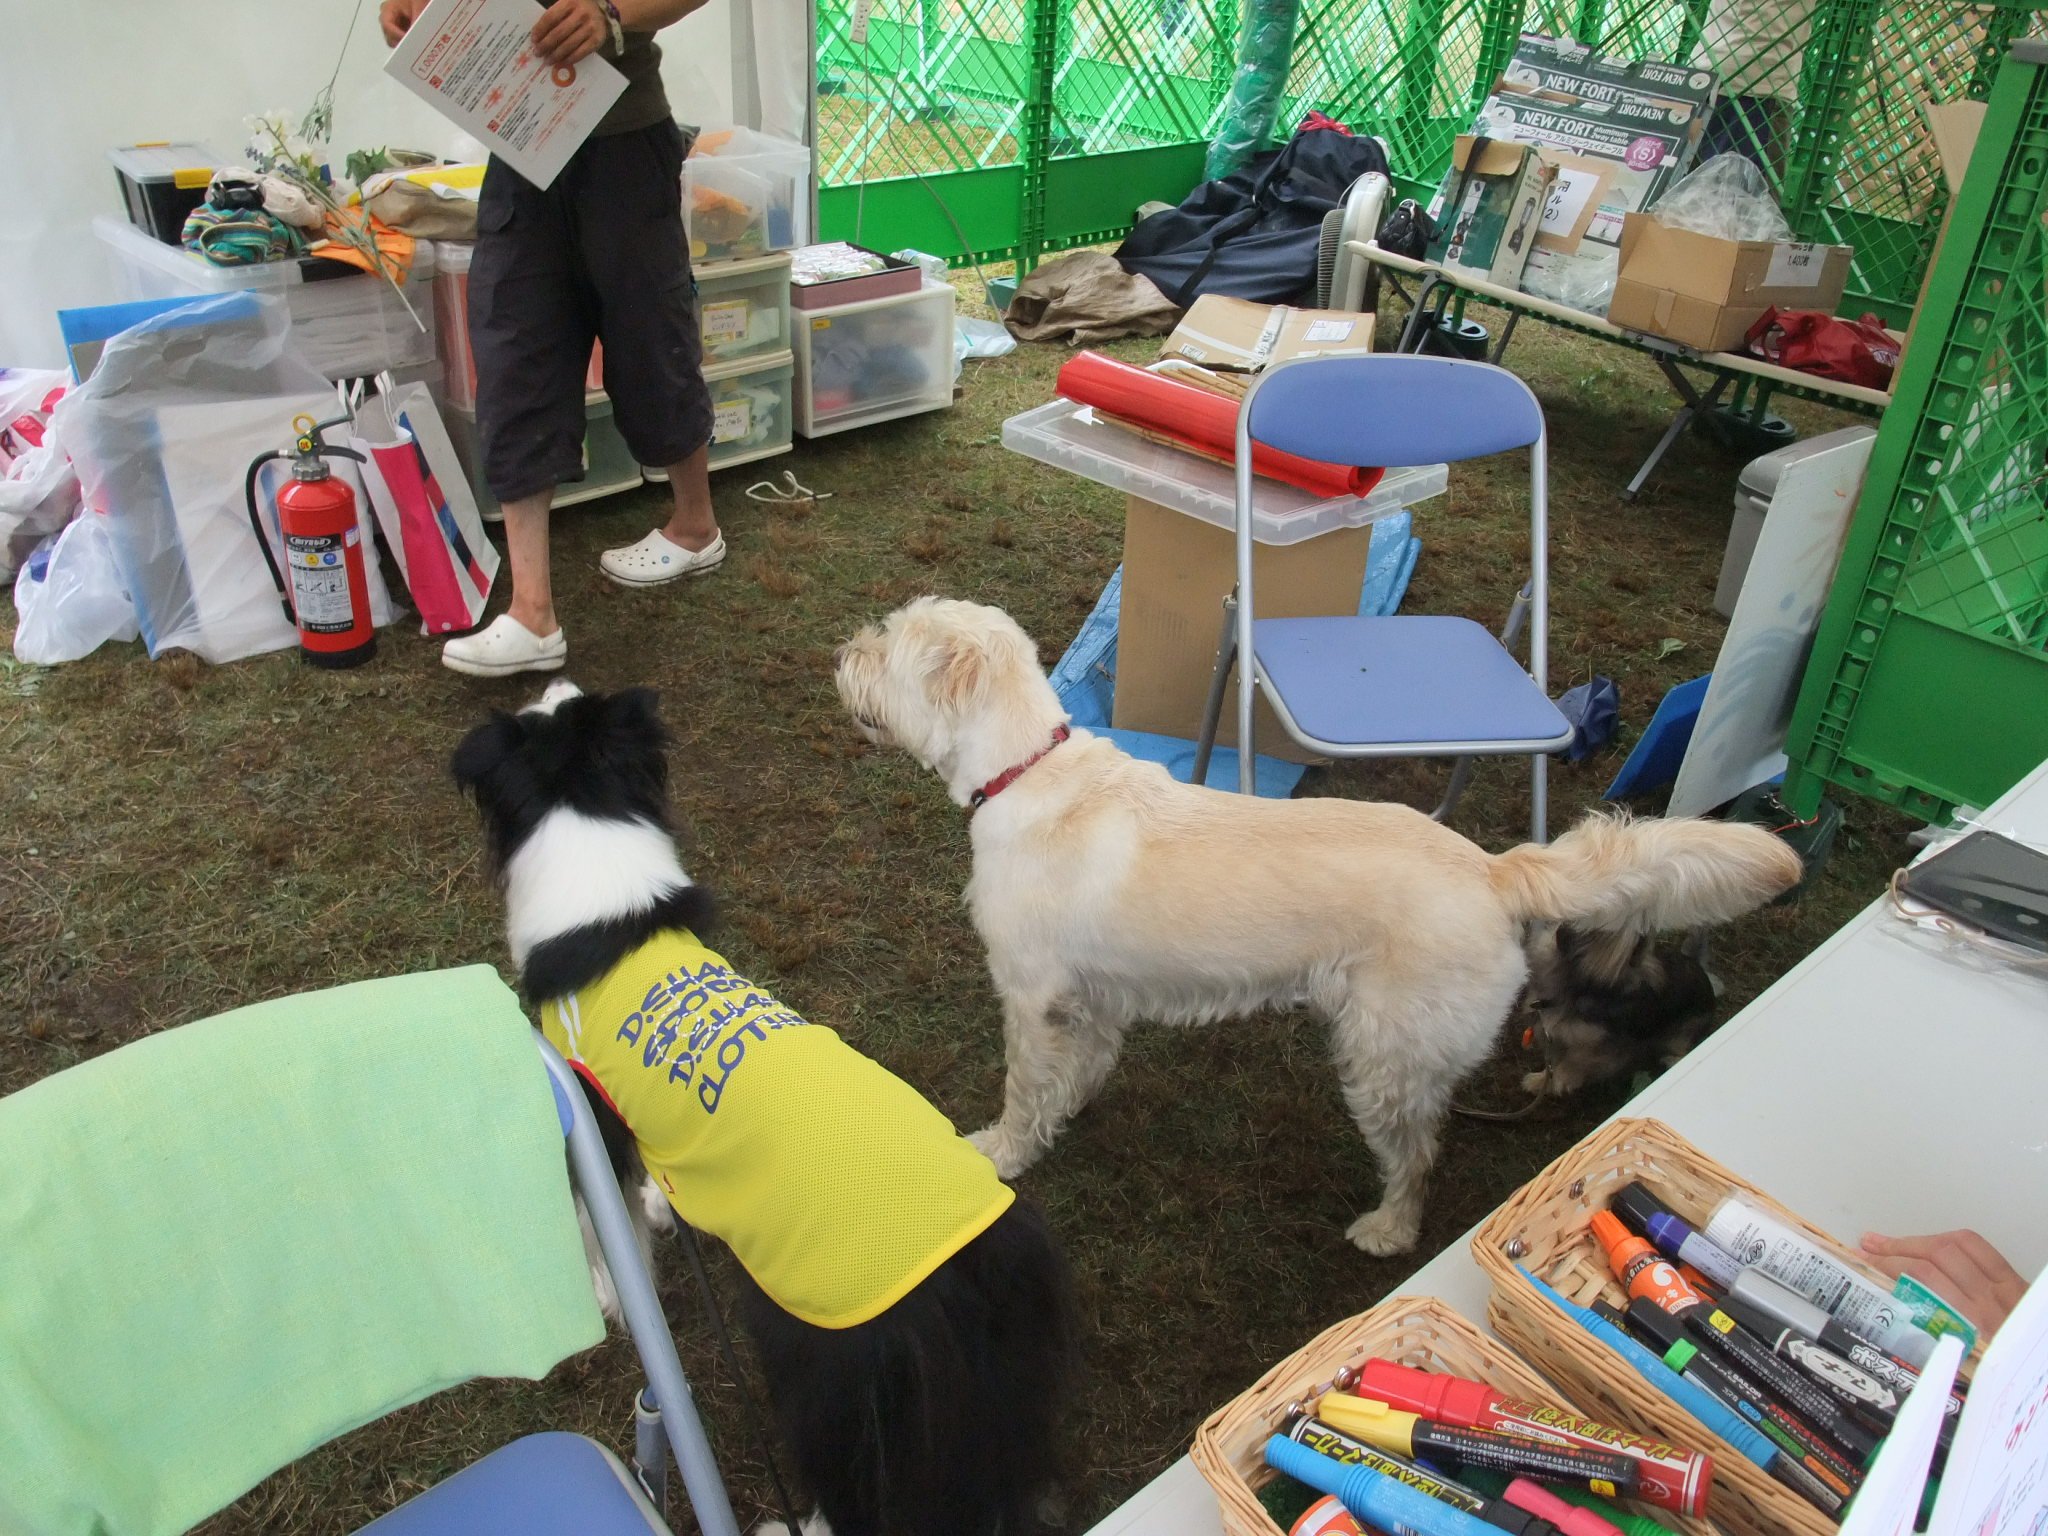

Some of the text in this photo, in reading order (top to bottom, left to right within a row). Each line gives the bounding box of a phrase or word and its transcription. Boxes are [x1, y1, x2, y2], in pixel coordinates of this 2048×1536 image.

[1640, 68, 1663, 82] FORT
[1663, 73, 1686, 86] NEW
[1545, 74, 1617, 102] NEW FORT
[1618, 103, 1665, 120] NEW FORT
[1521, 110, 1629, 138] NEW FORT aluminum
[1610, 136, 1629, 146] table
[1813, 1354, 1868, 1391] マッキー
[1731, 1373, 1763, 1399] SAILOR
[1831, 1383, 1858, 1404] ゼブラ
[1532, 1407, 1686, 1459] 極太油性マーカー
